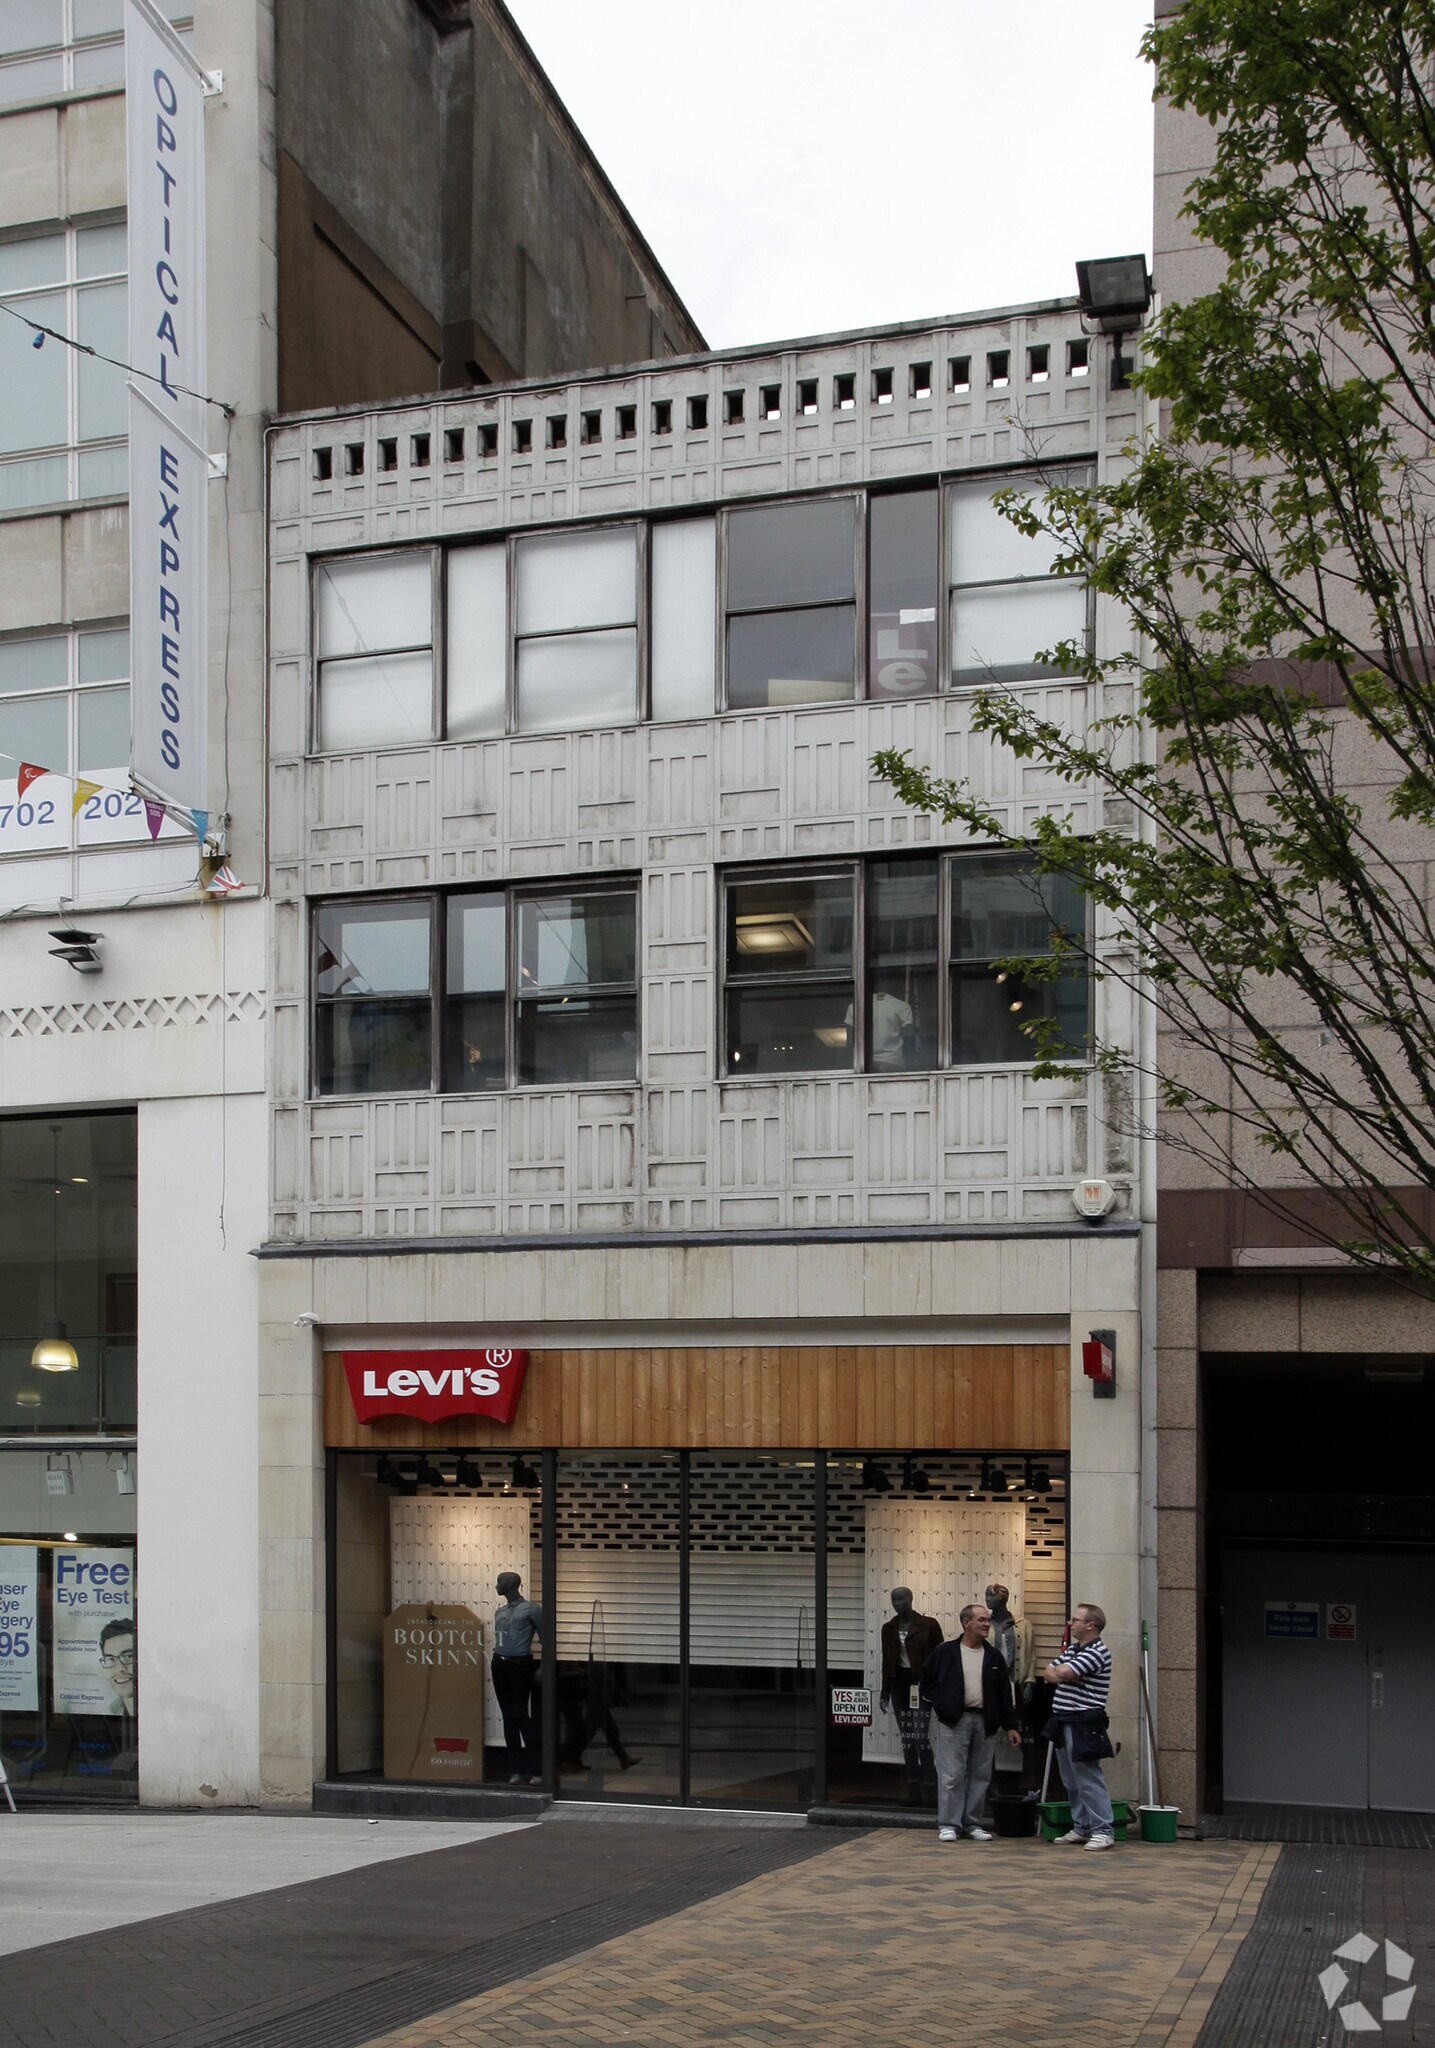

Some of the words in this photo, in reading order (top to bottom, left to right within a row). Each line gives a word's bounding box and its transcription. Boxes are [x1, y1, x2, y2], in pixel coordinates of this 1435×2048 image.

[153, 68, 180, 402] OPTICAL
[157, 444, 181, 771] EXPRESS
[0, 800, 55, 828] 702
[84, 793, 142, 820] 202
[57, 1555, 130, 1586] Free
[0, 1597, 20, 1613] ye
[57, 1588, 88, 1606] Eye
[93, 1588, 130, 1604] Test
[0, 1616, 34, 1630] gery
[406, 1618, 456, 1626] INTRODUCING
[0, 1632, 30, 1658] 95
[81, 1694, 105, 1702] Express
[833, 1691, 853, 1702] YES
[834, 1703, 856, 1712] OPEN
[858, 1704, 869, 1713] ON
[834, 1715, 869, 1724] LEVI.COM
